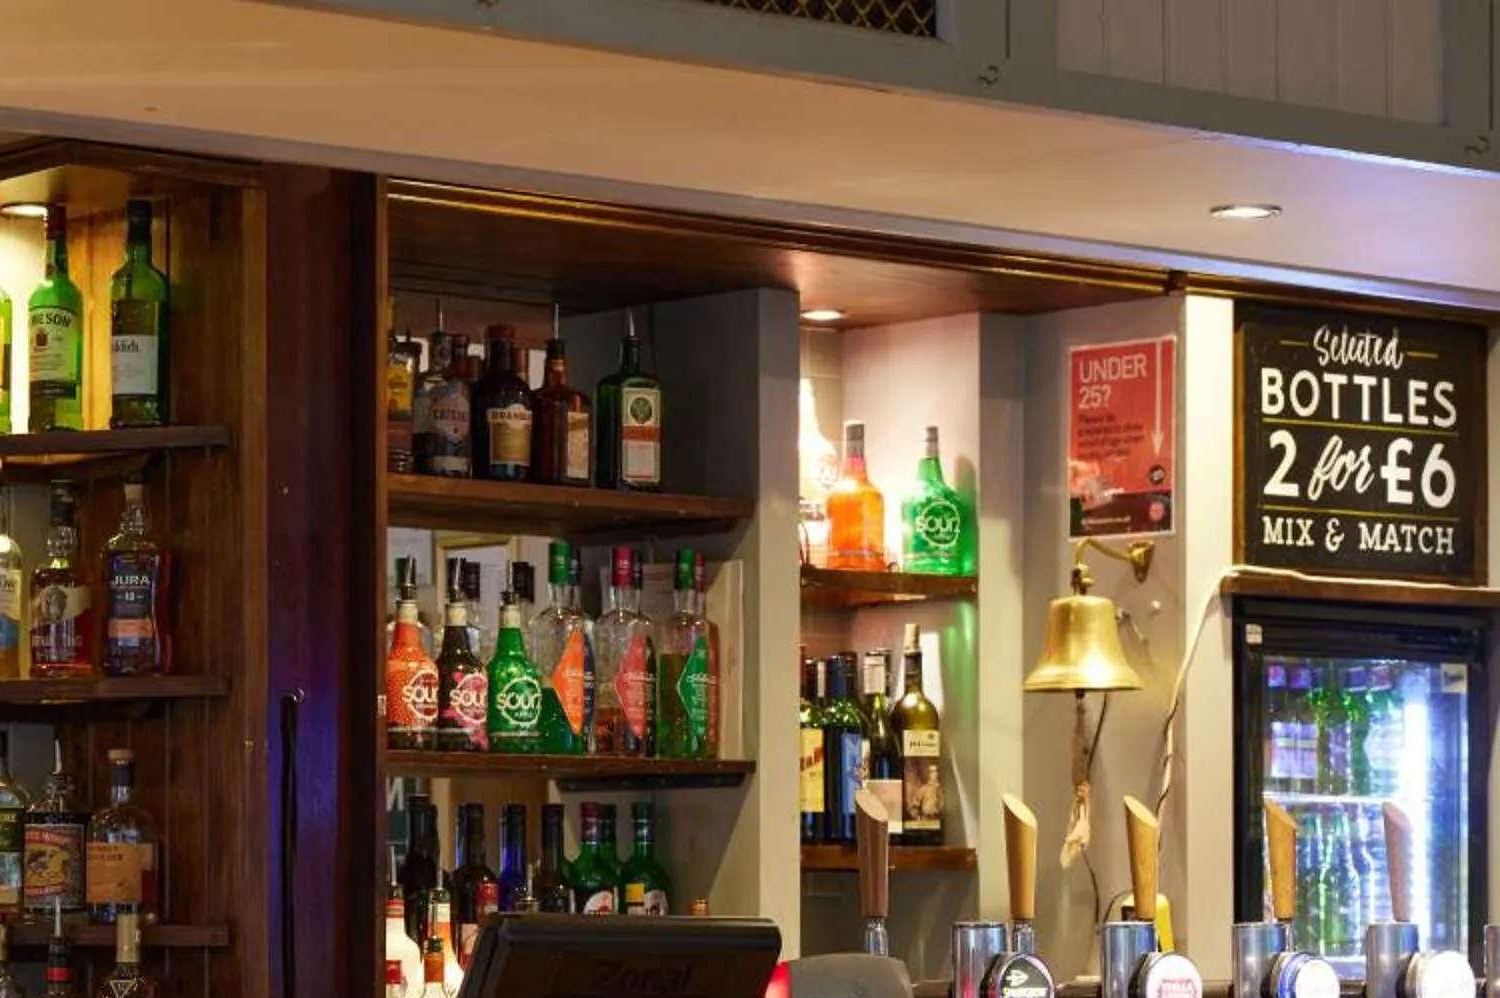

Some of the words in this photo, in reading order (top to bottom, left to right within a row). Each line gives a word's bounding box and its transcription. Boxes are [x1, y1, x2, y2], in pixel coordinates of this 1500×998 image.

[1313, 325, 1404, 370] Selected
[1079, 353, 1147, 383] UNDER
[1078, 384, 1112, 410] 25?
[1261, 367, 1457, 428] BOTTLES
[1263, 429, 1300, 498] 2
[1307, 434, 1375, 501] for
[1380, 437, 1456, 509] £6
[1262, 515, 1315, 547] MIX
[1325, 517, 1345, 553] &
[1358, 522, 1455, 555] MATCH
[115, 575, 151, 586] JURA
